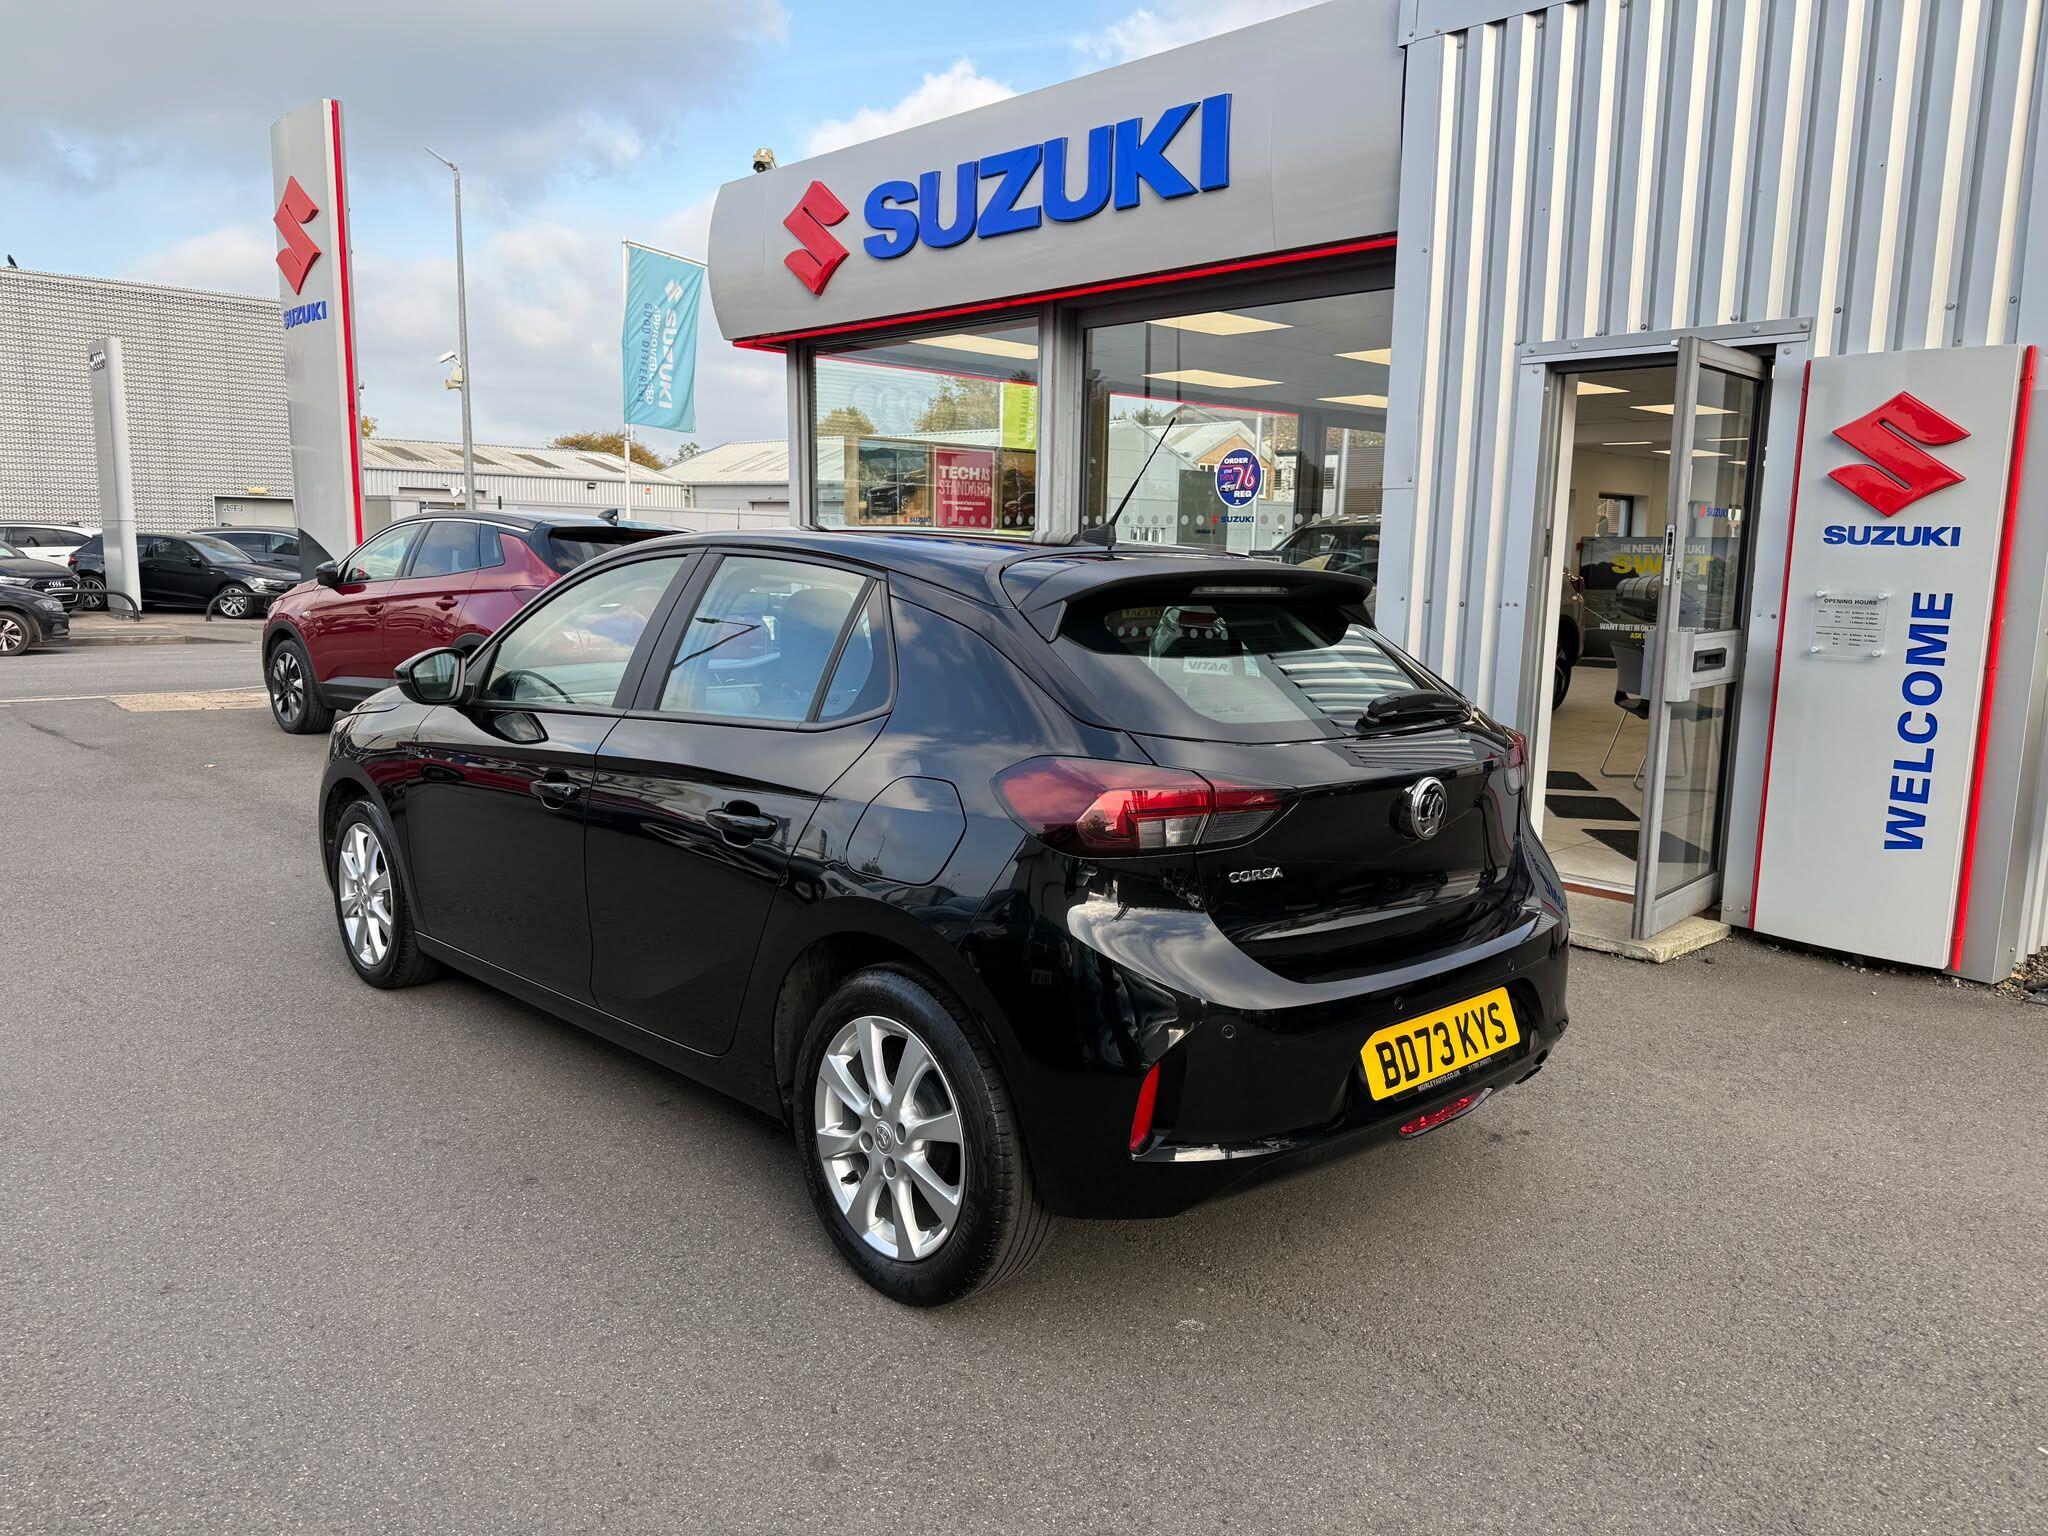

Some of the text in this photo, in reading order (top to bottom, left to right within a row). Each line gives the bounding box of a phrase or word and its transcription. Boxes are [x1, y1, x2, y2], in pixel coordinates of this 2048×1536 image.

[863, 93, 1232, 260] SUZUKI
[283, 301, 327, 330] SUZUKI
[641, 302, 653, 335] GOOD
[658, 308, 678, 409] SUZUKI
[939, 465, 990, 481] TECH AS
[1233, 464, 1255, 490] 76
[1220, 515, 1255, 523] SUZUKI
[1620, 544, 1631, 553] THE
[1631, 544, 1664, 553] NEW
[1823, 525, 1961, 547] SUZUKI
[1600, 623, 1618, 631] WANT
[1883, 592, 1953, 850] WELCOME
[1228, 866, 1284, 884] CORSA
[1375, 1001, 1507, 1090] BD73 KYS
